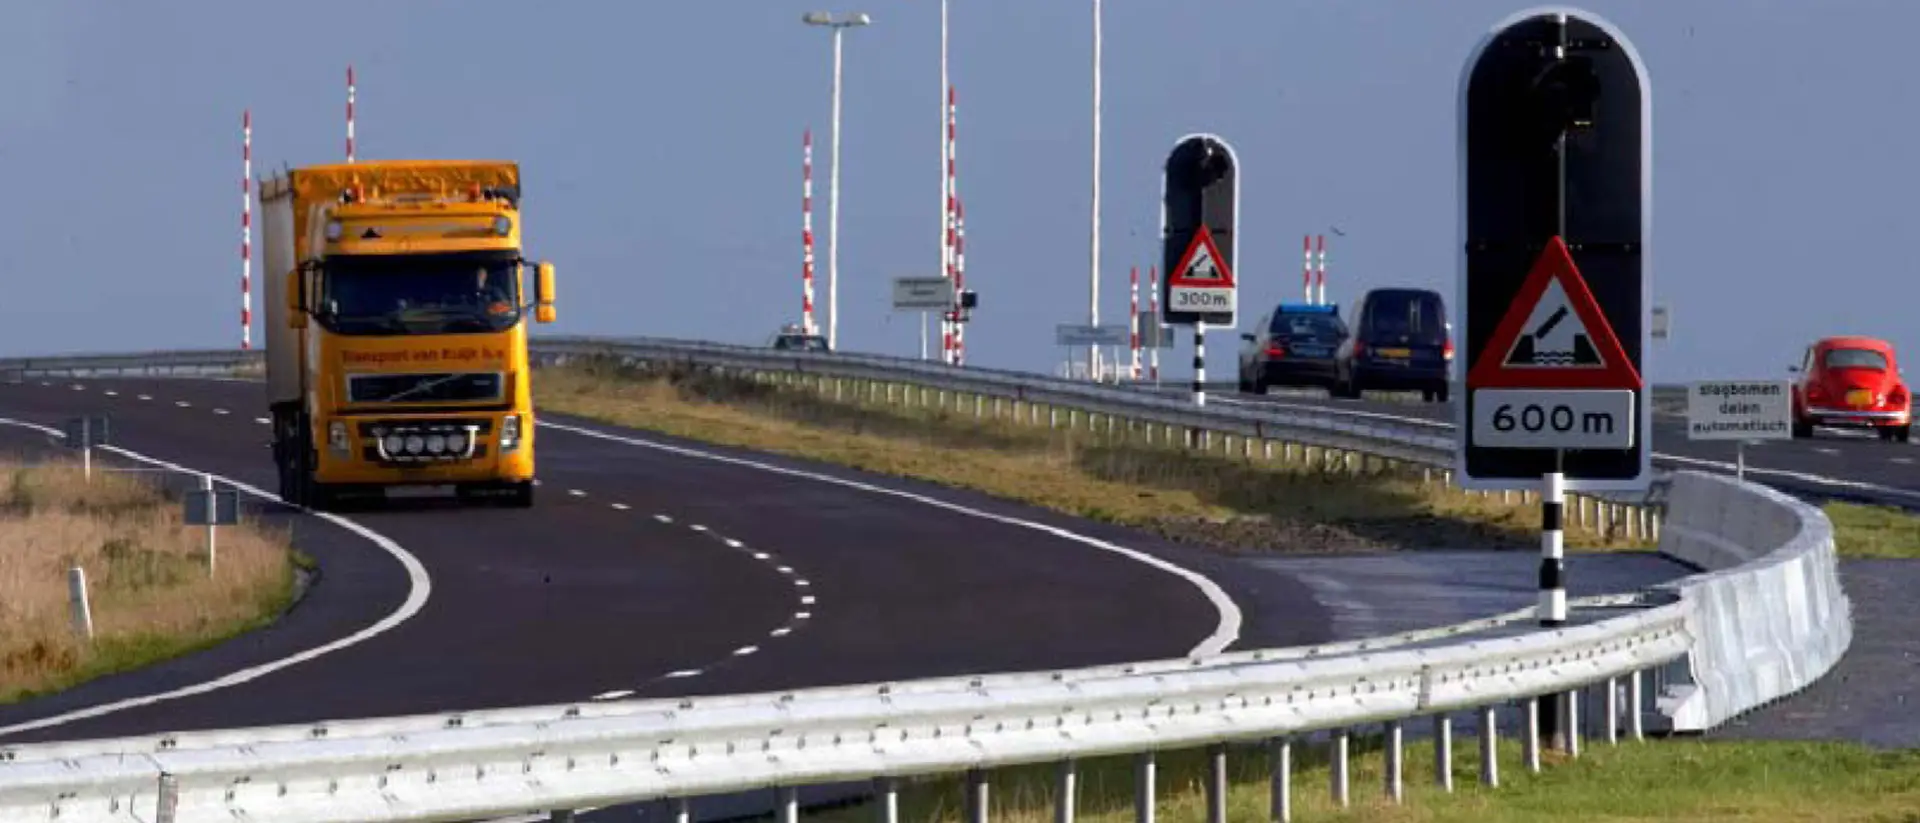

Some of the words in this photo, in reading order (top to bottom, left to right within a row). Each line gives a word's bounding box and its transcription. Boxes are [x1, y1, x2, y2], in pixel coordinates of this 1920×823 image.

[1179, 292, 1211, 305] 300
[1213, 295, 1227, 305] m
[1493, 404, 1574, 433] 600
[1582, 411, 1613, 434] m
